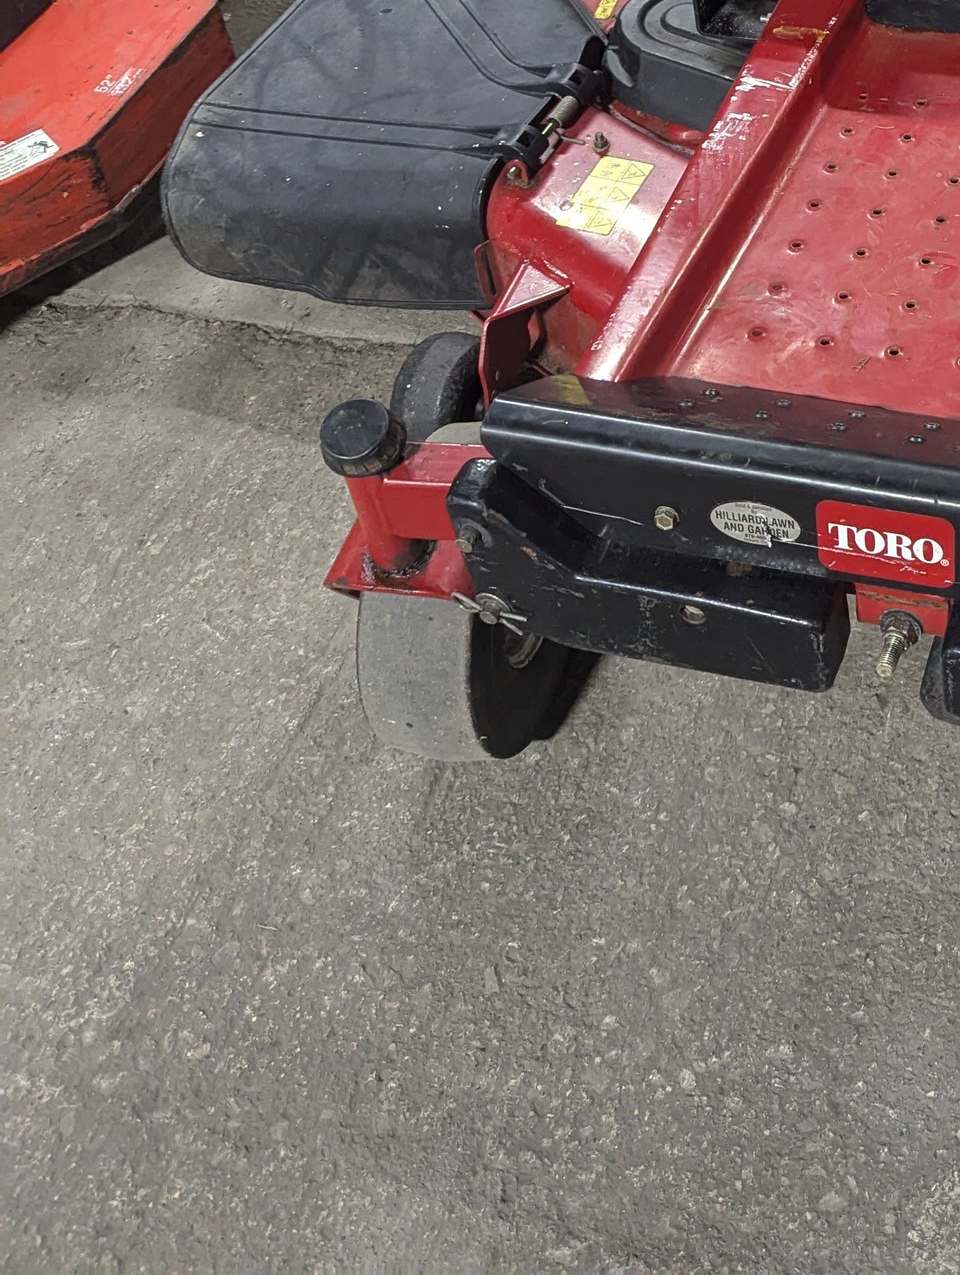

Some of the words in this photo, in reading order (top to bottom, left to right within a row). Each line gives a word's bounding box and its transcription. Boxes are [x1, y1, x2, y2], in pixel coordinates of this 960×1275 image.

[715, 510, 764, 525] HILLIARD
[723, 522, 744, 532] AND
[828, 522, 944, 565] TORO
